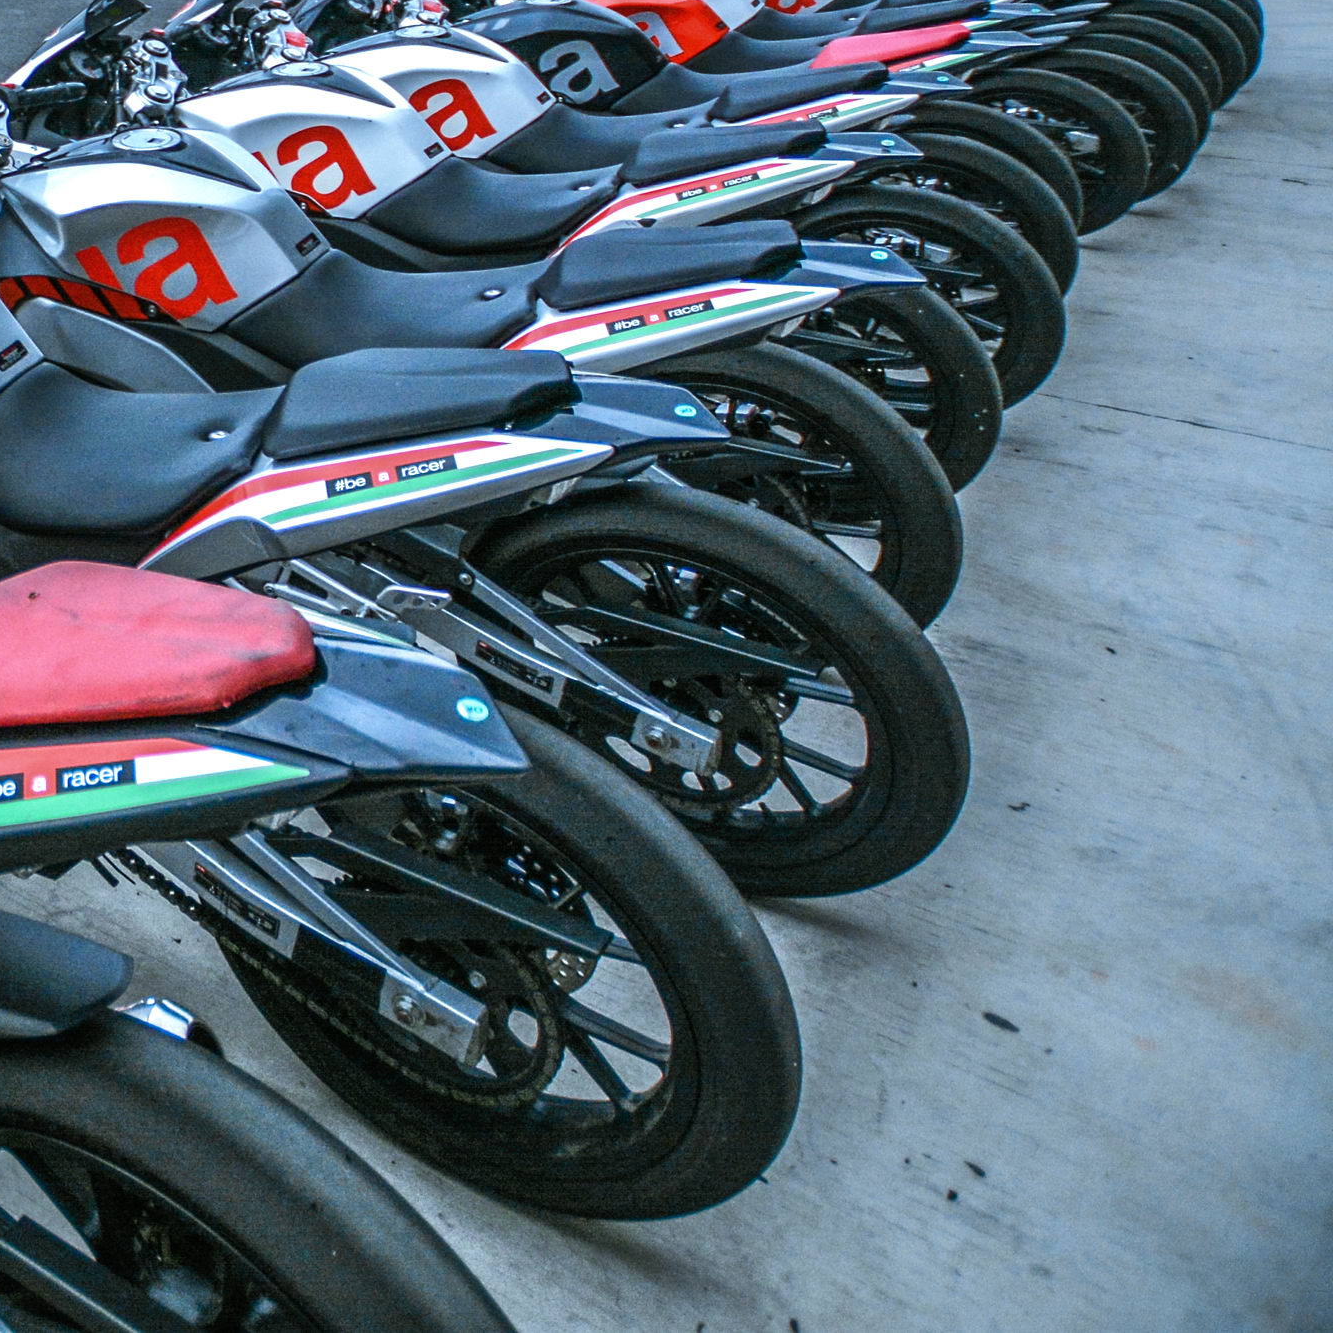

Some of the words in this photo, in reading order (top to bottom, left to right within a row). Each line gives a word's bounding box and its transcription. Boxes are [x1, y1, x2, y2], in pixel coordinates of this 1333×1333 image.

[538, 38, 621, 105] a
[408, 77, 498, 153] a
[724, 174, 753, 187] racer
[613, 316, 641, 331] #be
[649, 314, 659, 323] a
[667, 302, 706, 317] racer
[333, 474, 367, 492] #be
[377, 471, 390, 483] a
[400, 456, 447, 477] racer
[31, 775, 47, 792] a
[61, 763, 124, 788] racer
